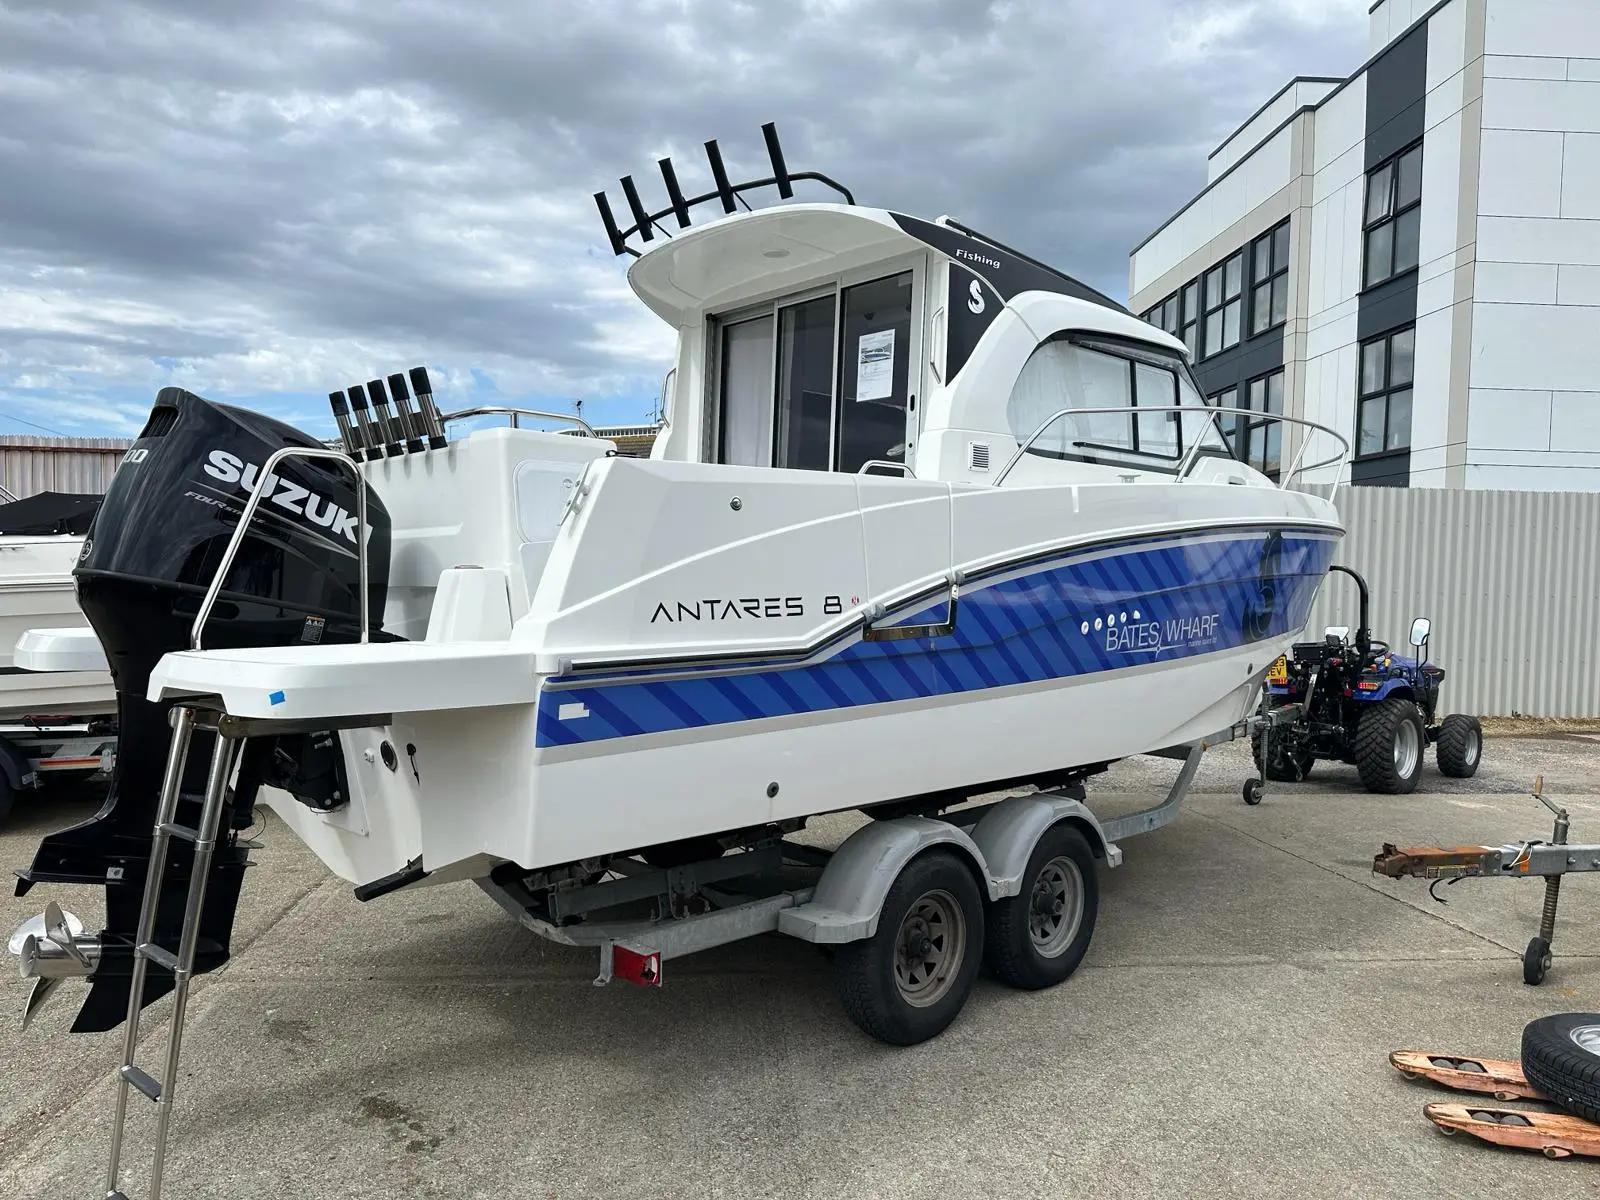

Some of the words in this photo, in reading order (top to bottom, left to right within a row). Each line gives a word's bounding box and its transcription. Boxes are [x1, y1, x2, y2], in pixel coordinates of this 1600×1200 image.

[955, 248, 1001, 269] Fishing
[650, 596, 804, 624] ANTARES
[823, 594, 843, 615] 8
[1106, 621, 1160, 652] BATES
[1166, 614, 1220, 643] WHARF
